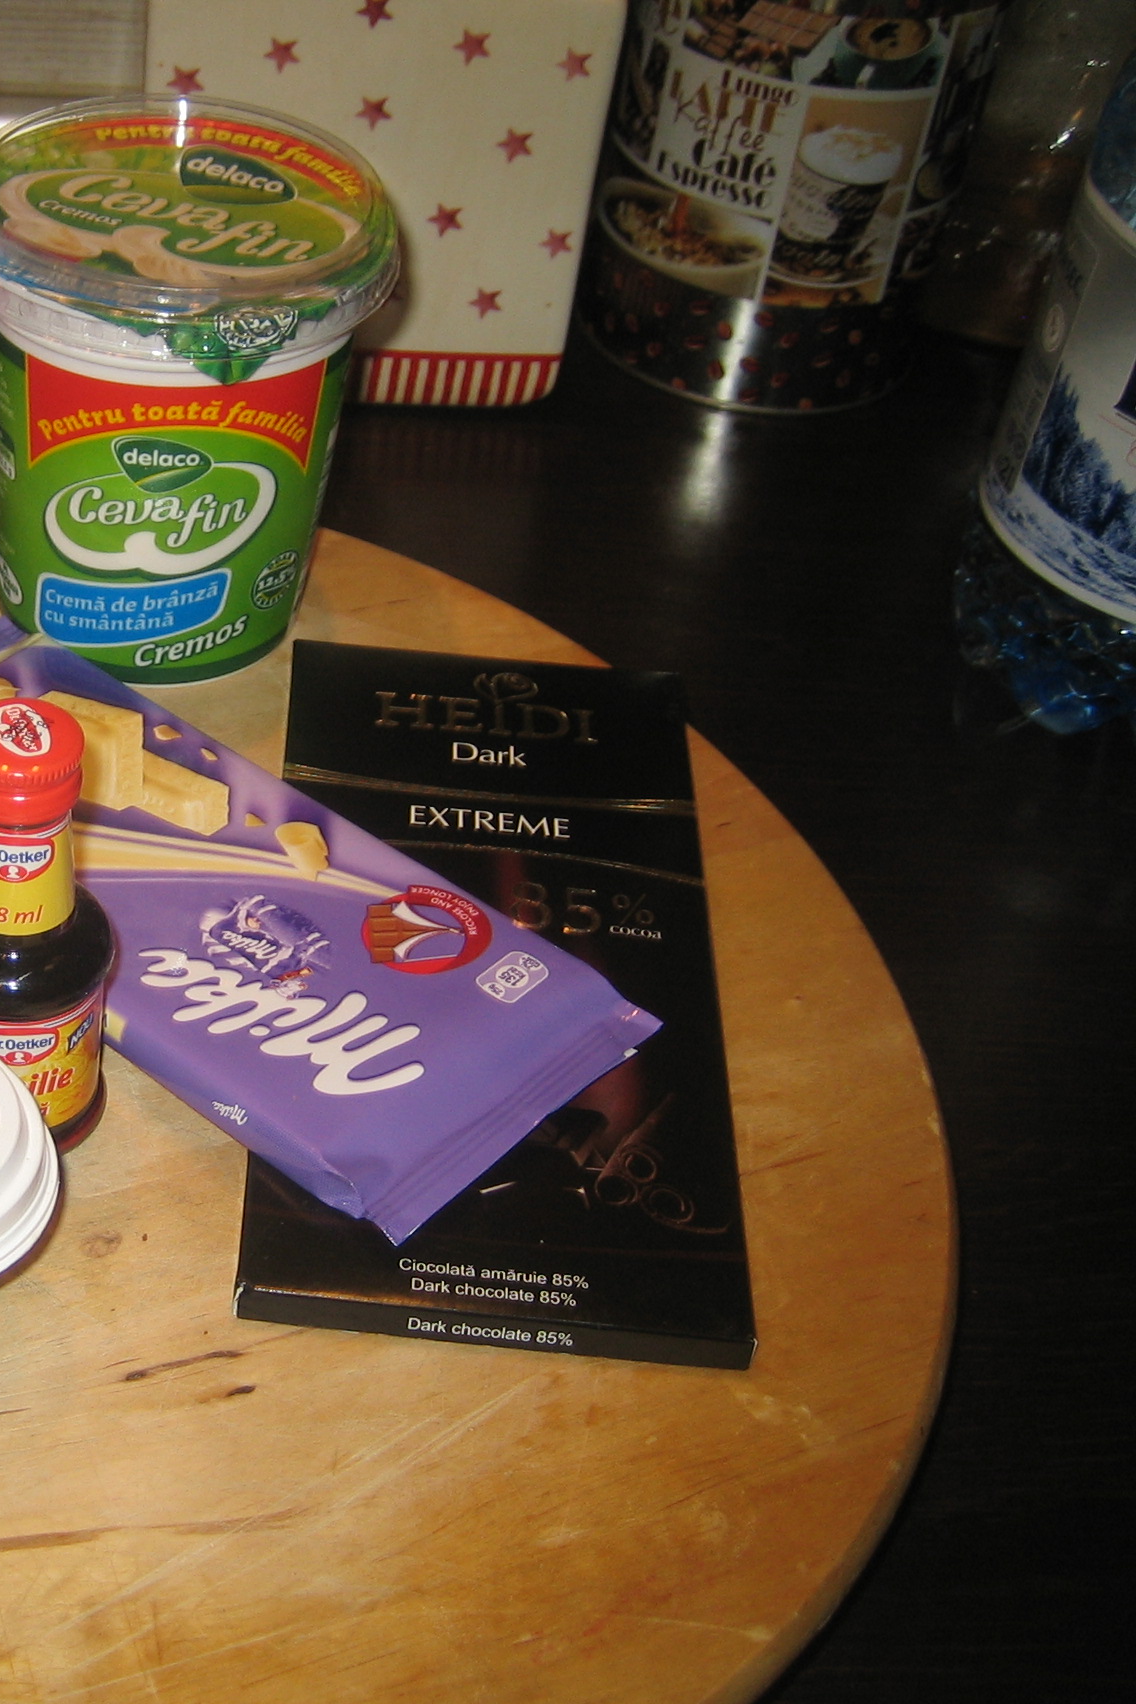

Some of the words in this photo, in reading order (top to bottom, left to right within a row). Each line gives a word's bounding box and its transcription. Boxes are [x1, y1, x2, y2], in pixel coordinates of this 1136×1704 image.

[673, 100, 765, 155] Kaffee
[186, 155, 286, 194] delaco
[692, 138, 777, 187] Café
[657, 151, 771, 208] Espresso
[37, 200, 123, 227] Cremos
[37, 408, 126, 441] Pentru
[132, 401, 220, 422] toată
[217, 402, 308, 444] familia
[122, 448, 201, 468] delaco
[44, 587, 106, 612] Cremă
[110, 592, 137, 613] de
[142, 581, 220, 612] brânză
[44, 607, 66, 626] cu
[68, 610, 175, 632] smântână
[133, 614, 248, 669] Cremos
[374, 690, 599, 744] HEIDI
[451, 742, 527, 768] Dark
[408, 805, 570, 839] EXTREME
[411, 886, 452, 900] LONGER
[431, 897, 453, 908] AND
[452, 897, 479, 916] ENJOY
[13, 904, 43, 924] ml
[452, 907, 477, 935] RECLOSE
[221, 930, 279, 960] Milka
[608, 924, 663, 940] cocoa
[498, 971, 521, 986] 135
[138, 946, 425, 1095] Milka
[27, 1067, 74, 1096] ilie
[211, 1101, 249, 1126] Milka
[398, 1257, 476, 1279] Ciocolată
[480, 1266, 547, 1286] amăruie
[552, 1271, 590, 1290] 85%
[410, 1277, 451, 1295] Dark
[454, 1281, 536, 1304] chocolate
[539, 1289, 578, 1308] 85%
[406, 1316, 447, 1335] Dark
[451, 1321, 531, 1344] chocolate
[536, 1329, 574, 1348] 85%
